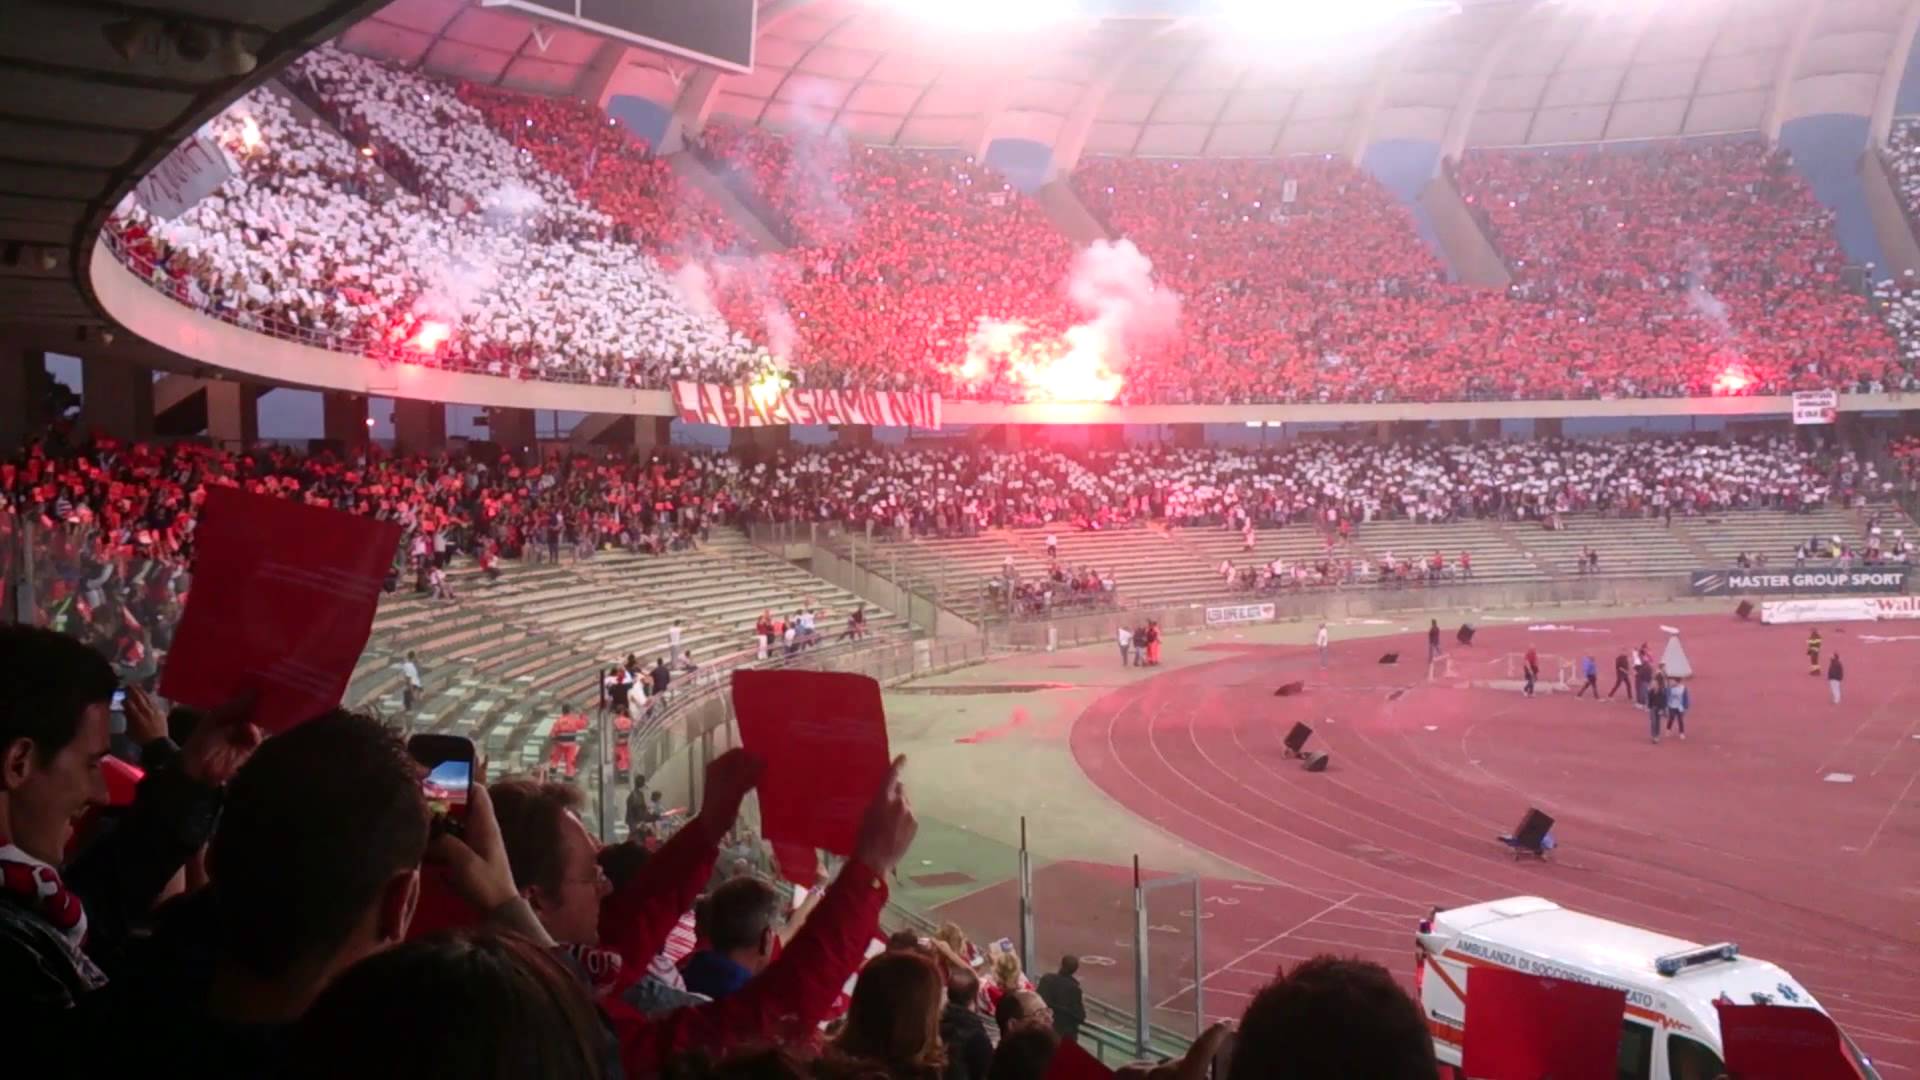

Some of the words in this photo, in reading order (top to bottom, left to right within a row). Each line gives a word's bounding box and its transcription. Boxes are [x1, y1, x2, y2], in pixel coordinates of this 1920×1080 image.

[1729, 575, 1790, 588] MASTER
[1792, 573, 1849, 586] GROUP
[1851, 573, 1903, 585] SPORT
[1456, 940, 1517, 968] AMBULANZA
[1518, 957, 1530, 970] DI
